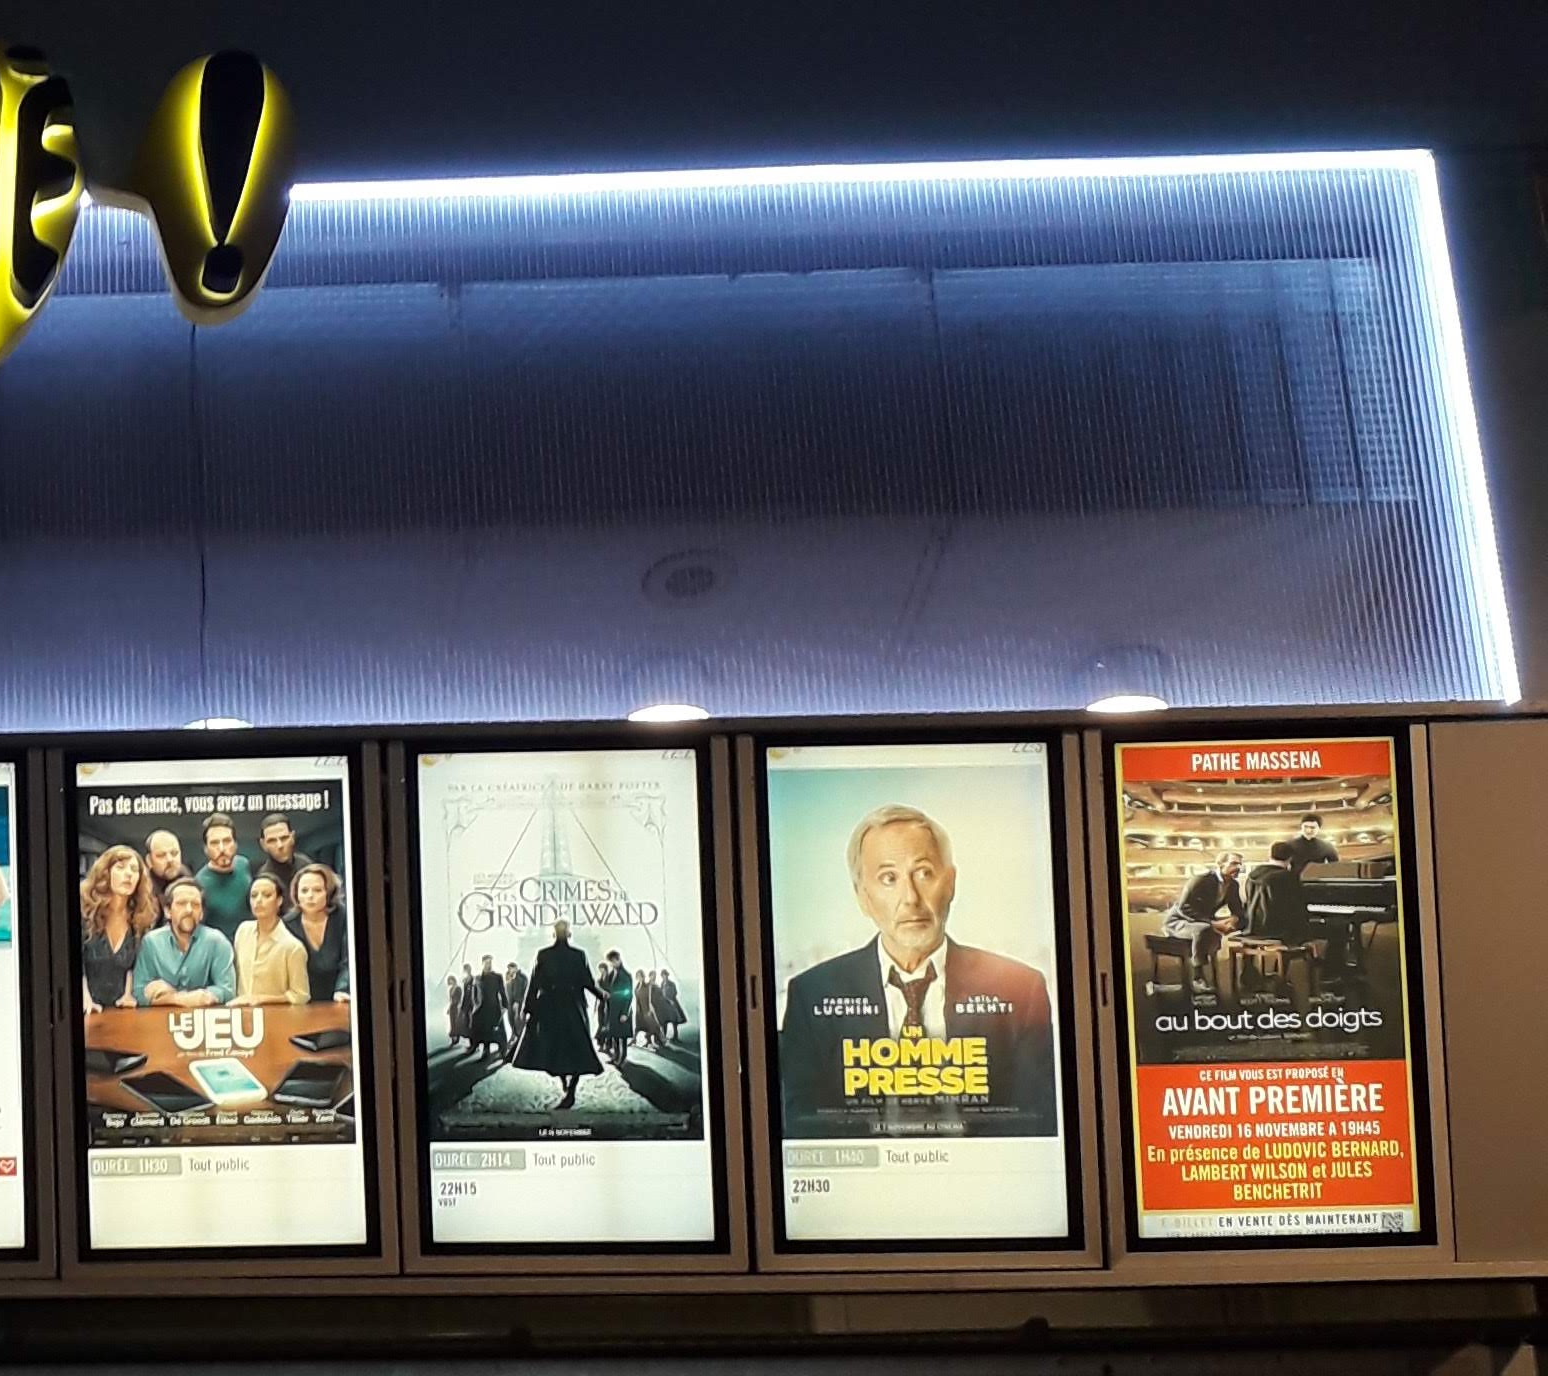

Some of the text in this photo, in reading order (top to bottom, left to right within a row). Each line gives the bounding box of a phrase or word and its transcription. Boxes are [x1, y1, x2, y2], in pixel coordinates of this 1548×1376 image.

[1191, 750, 1321, 772] PATHE MASSENA
[89, 795, 113, 816] Pas
[116, 794, 131, 814] de
[133, 793, 182, 815] chance,
[185, 795, 214, 813] vous
[217, 794, 246, 812] avez
[248, 793, 264, 811] un
[266, 792, 321, 813] message
[520, 876, 612, 903] CRIMES
[458, 891, 659, 933] GRINDELWALD
[813, 1002, 1013, 1016] LUCHINI BEKHTI
[169, 1012, 193, 1032] LE
[173, 1007, 264, 1050] JEU
[1155, 1006, 1382, 1033] au bout des doigts
[902, 1026, 922, 1038] UN
[843, 1038, 988, 1067] HOMME
[1199, 1066, 1344, 1081] CE FILM VOUS EST PROPOSÉ EN
[1162, 1078, 1384, 1116] AVANT PREMIÈRE
[1169, 1121, 1380, 1140] VENDREDI 16 NOVEMBRE A 19H45
[481, 1151, 512, 1167] 2H14
[533, 1152, 596, 1168] Tout public
[886, 1150, 949, 1164] Tout public
[1147, 1140, 1404, 1164] En présence de LUDOVIC BERNARD,
[189, 1158, 250, 1174] Tout public
[1181, 1161, 1373, 1182] LAMBERT WILSON et JULES
[439, 1181, 477, 1196] 22H15
[792, 1179, 830, 1193] 22H30
[1233, 1182, 1323, 1201] BENCHETRIT
[1218, 1212, 1378, 1227] EN VENTE DÈS MAINTENANT
